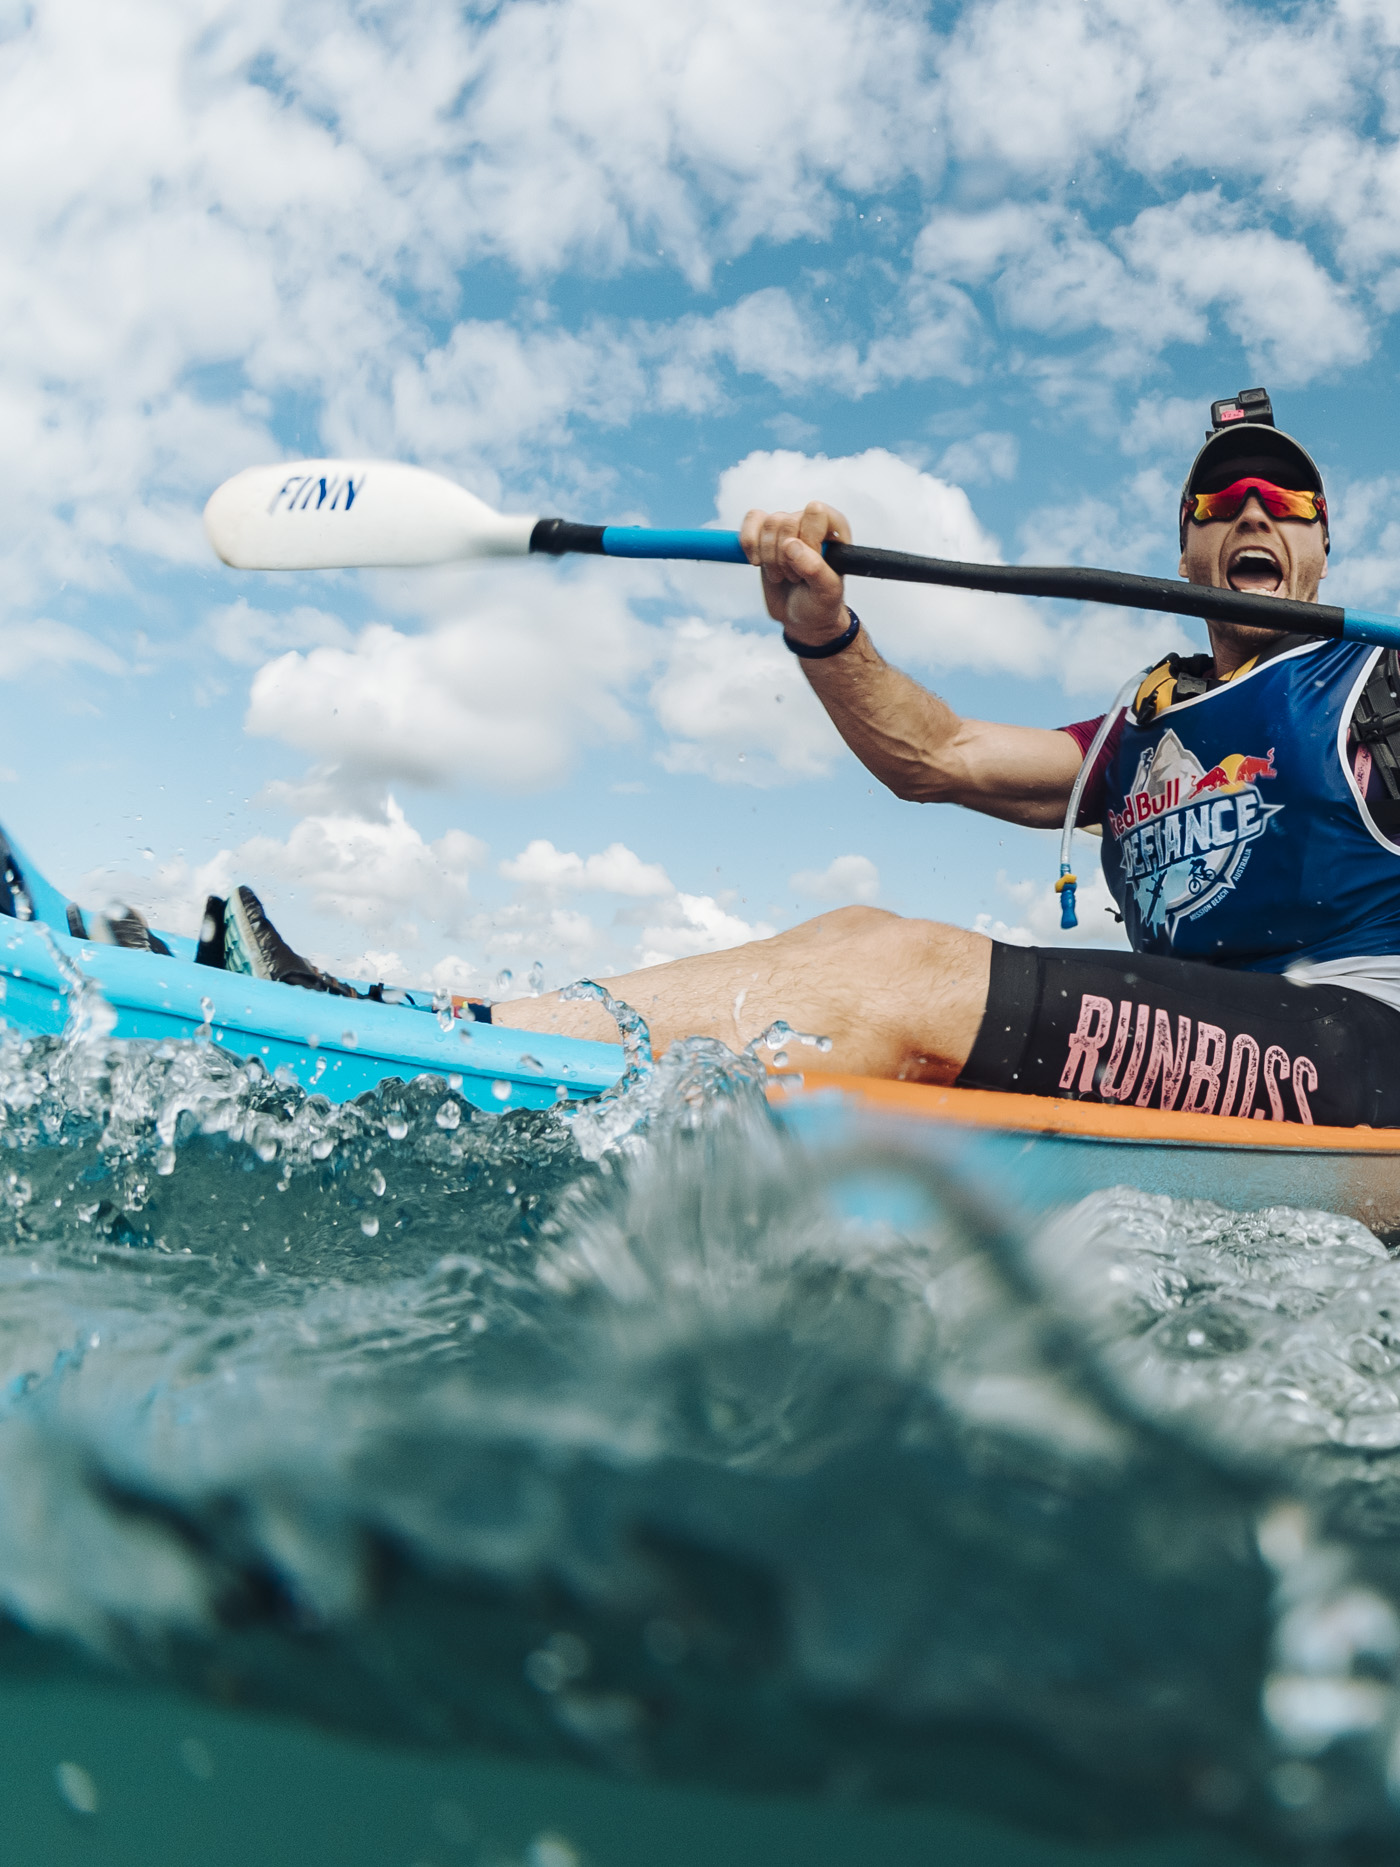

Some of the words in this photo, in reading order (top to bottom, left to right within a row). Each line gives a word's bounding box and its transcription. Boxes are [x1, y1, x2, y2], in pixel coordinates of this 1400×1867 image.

[267, 472, 367, 515] FINN
[1109, 794, 1135, 840] Red
[1136, 778, 1180, 822] Bull
[1121, 793, 1263, 878] DEFIANCE
[1232, 848, 1253, 882] AUSTRALIA
[1189, 901, 1213, 922] MISSION
[1212, 889, 1230, 907] BEACH
[1058, 994, 1318, 1125] RUNBOSS
